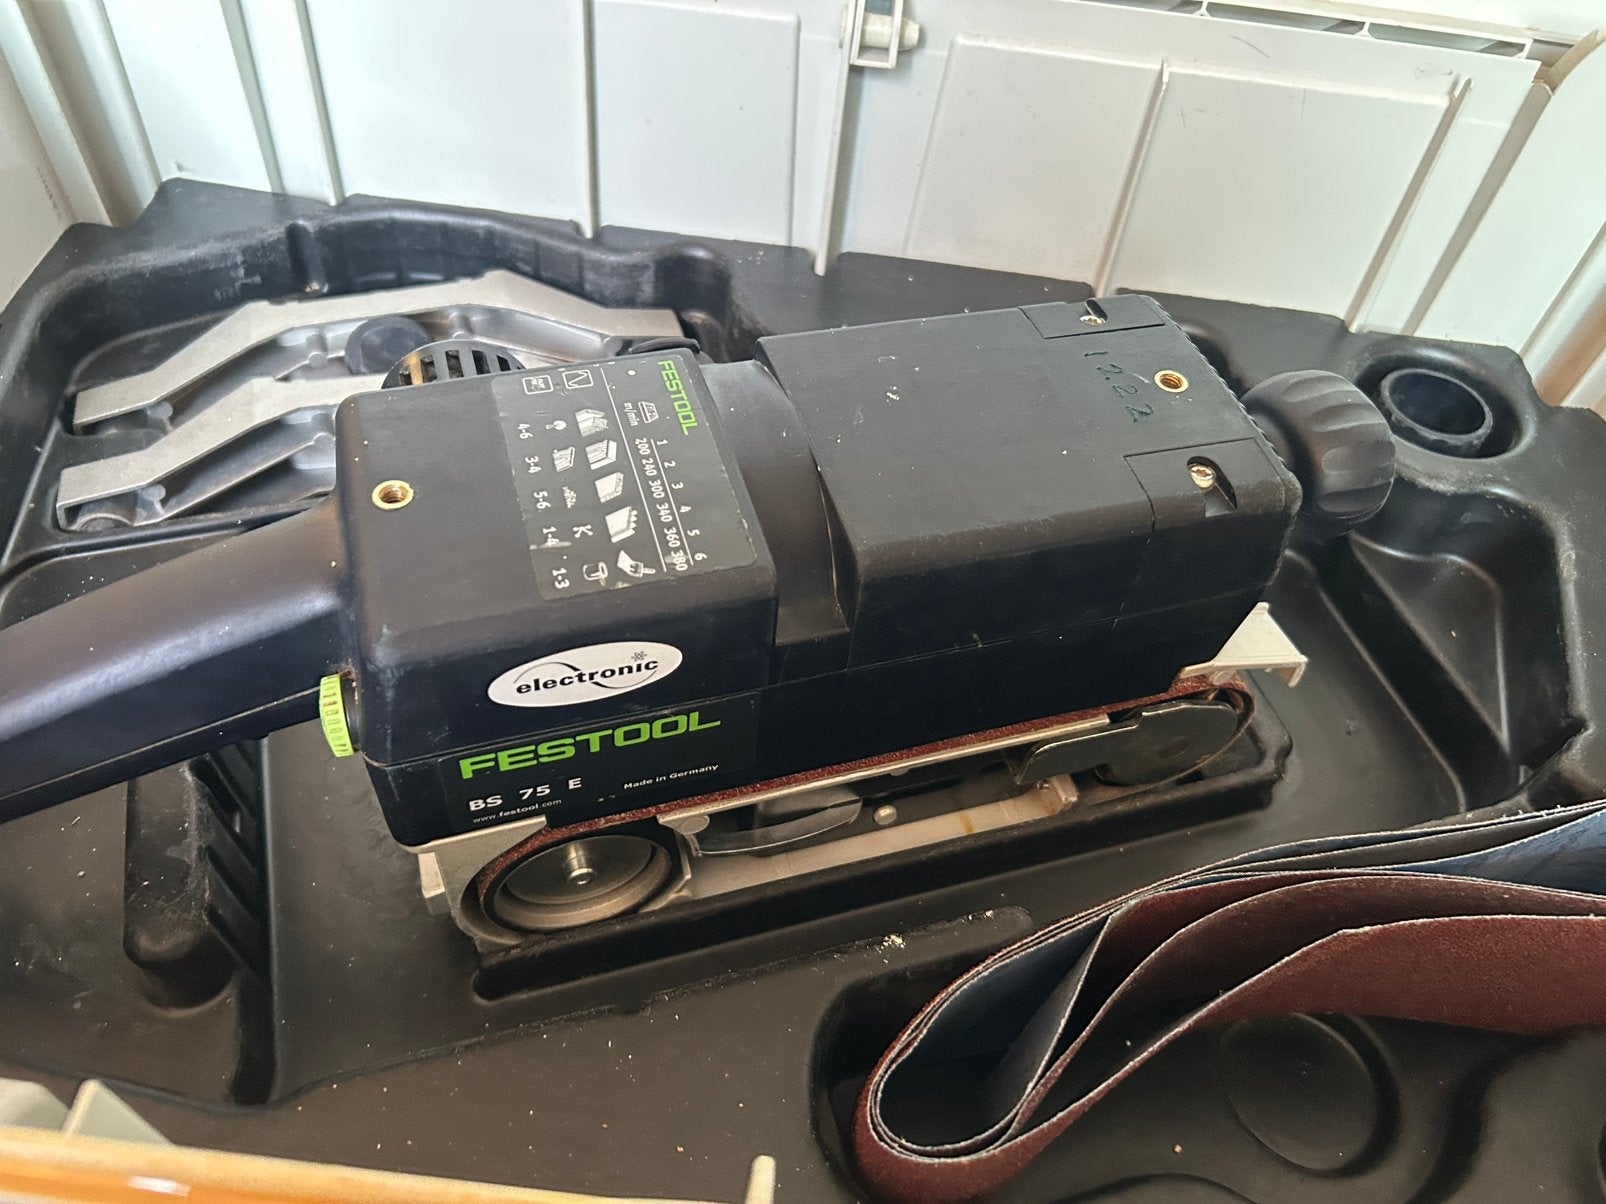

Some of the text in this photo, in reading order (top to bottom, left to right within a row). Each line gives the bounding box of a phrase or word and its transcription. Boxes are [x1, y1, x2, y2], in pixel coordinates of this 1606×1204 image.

[624, 402, 637, 426] m/min
[659, 360, 698, 435] FESTOOL
[635, 438, 688, 571] 200 240 300 340 360 380
[657, 439, 707, 561] 1 2 3 4 5 6
[516, 659, 659, 694] electronic
[459, 711, 721, 780] FESTOOL
[469, 777, 582, 811] BS 75 E
[623, 763, 719, 790] Made in Germany
[472, 800, 562, 823] www.festool.com
